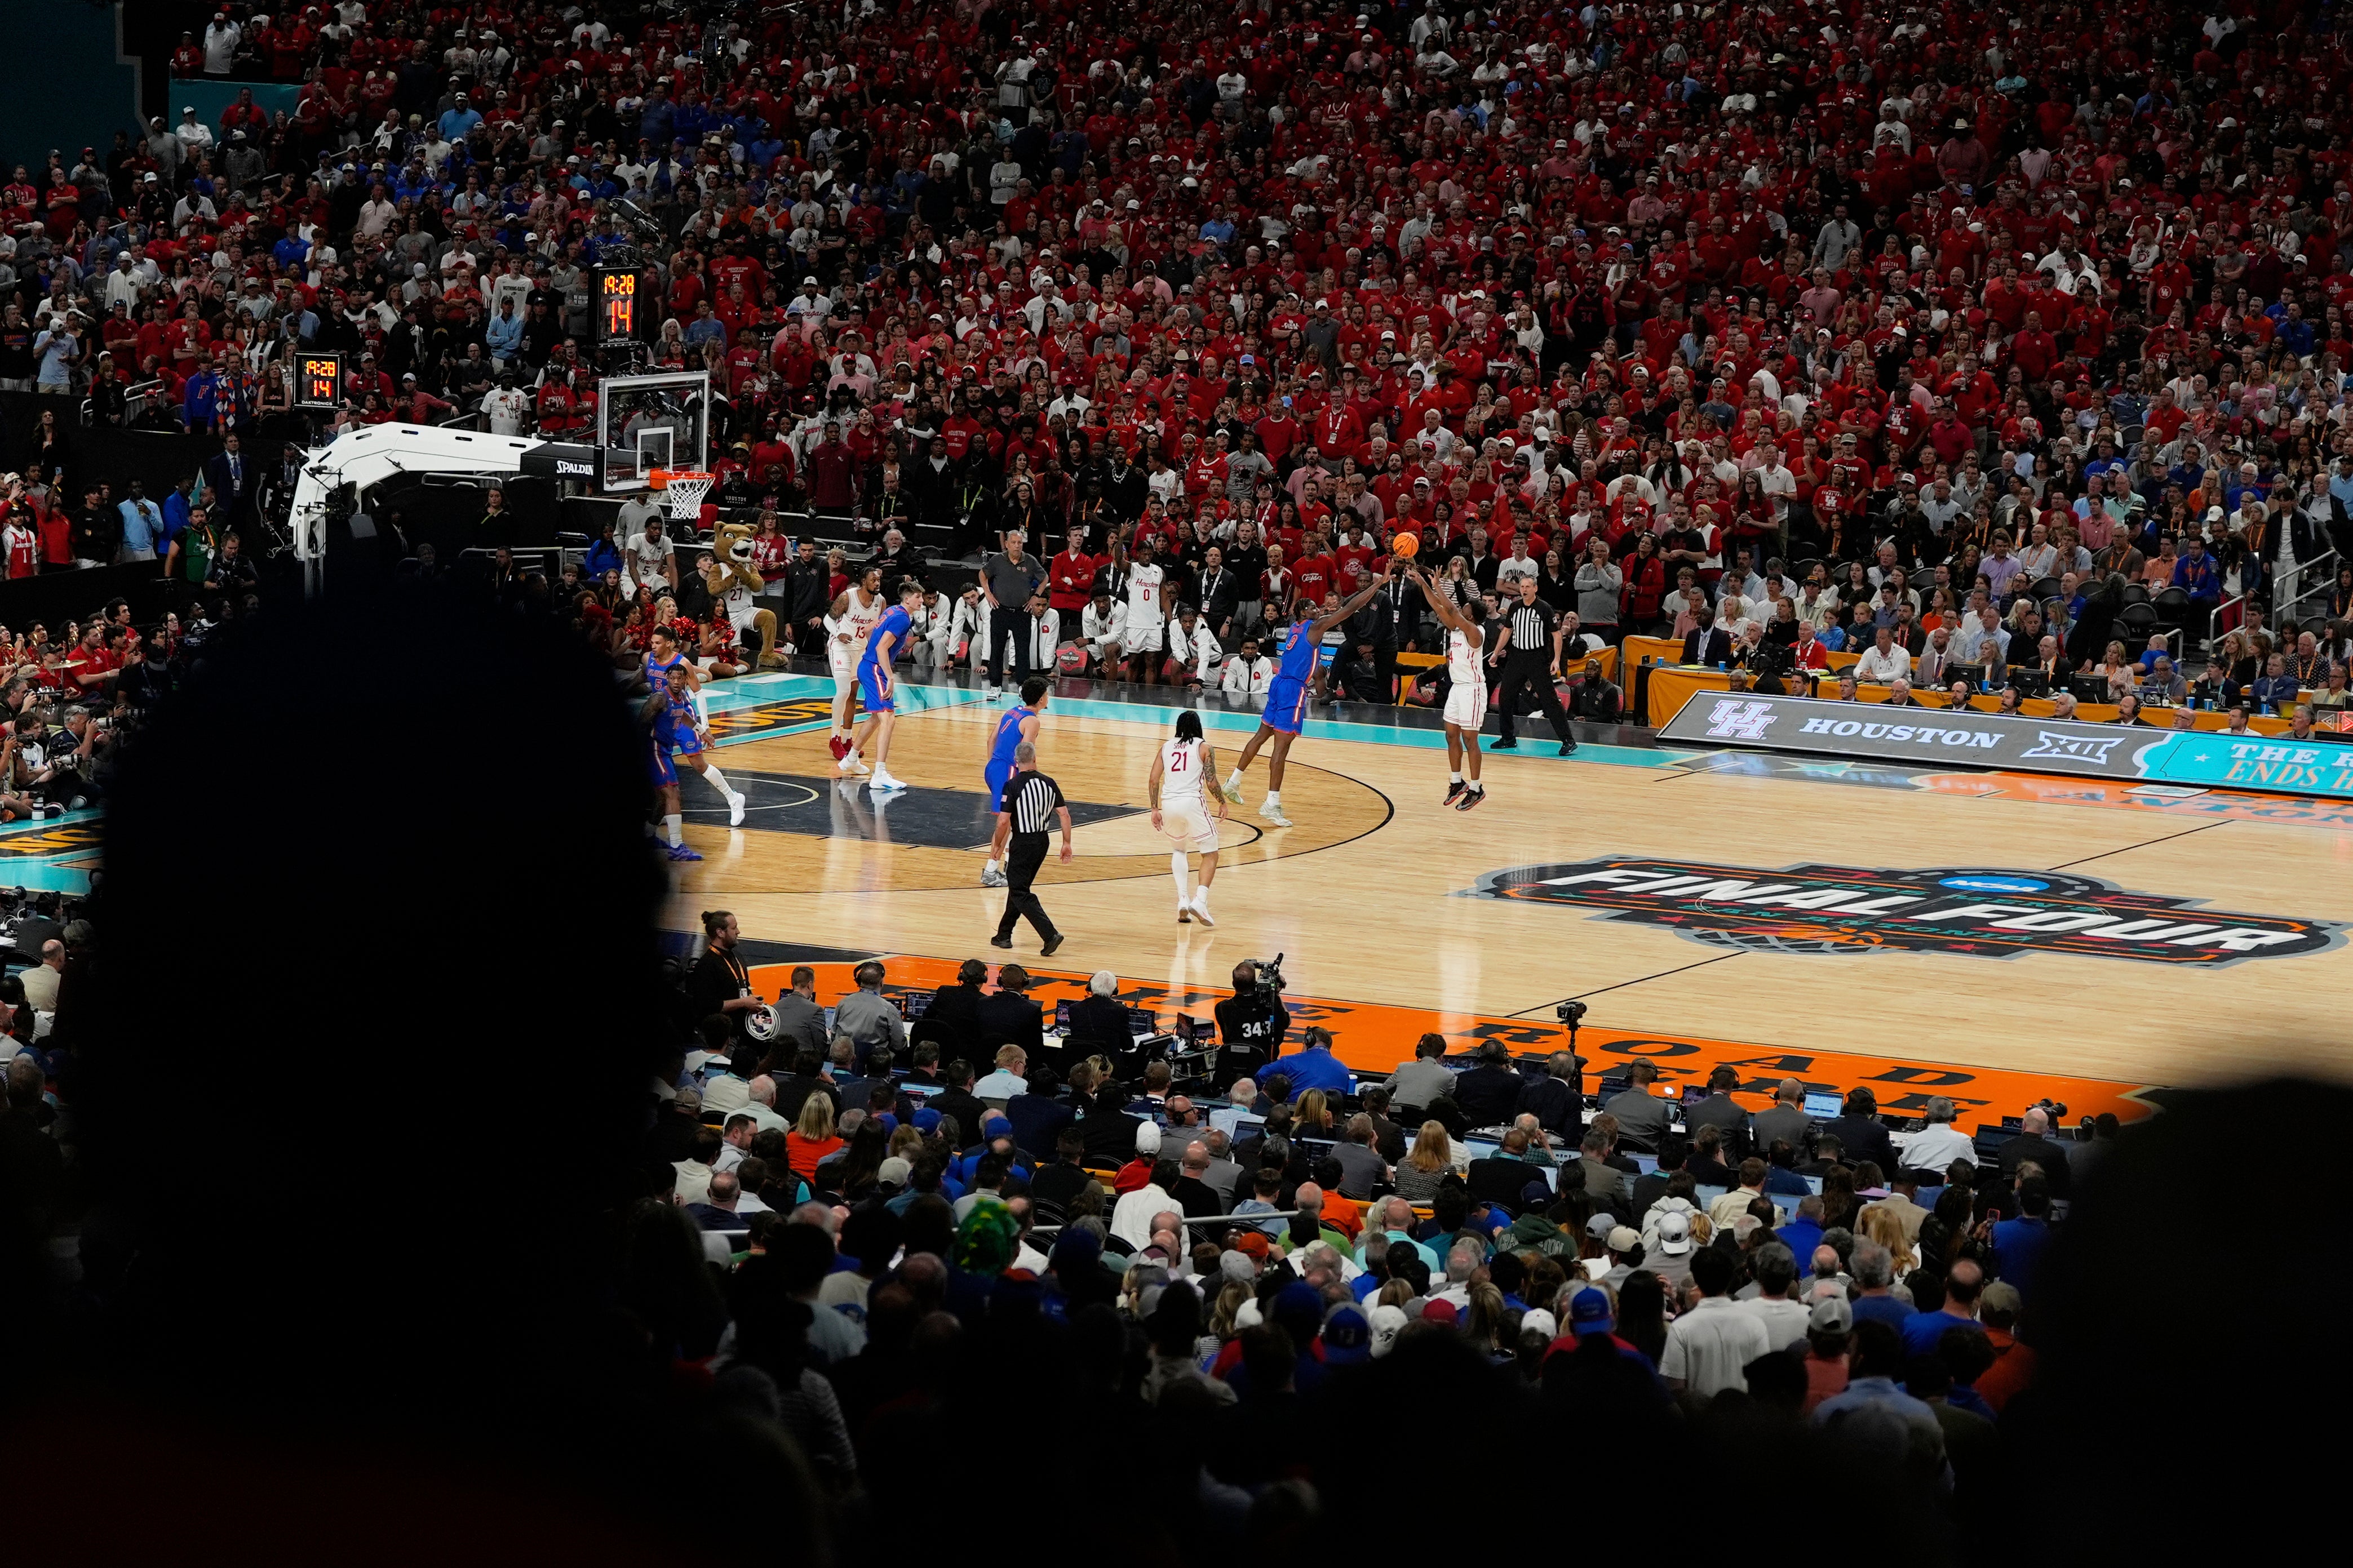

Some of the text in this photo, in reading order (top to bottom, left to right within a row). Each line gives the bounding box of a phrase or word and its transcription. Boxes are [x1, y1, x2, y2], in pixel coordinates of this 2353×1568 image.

[604, 274, 634, 296] 19:28
[611, 300, 632, 333] 14
[305, 359, 336, 377] 19:28
[312, 380, 330, 398] 14
[556, 460, 594, 476] SPALDIN
[638, 555, 659, 565] Houston
[642, 566, 649, 575] 5
[1135, 578, 1158, 588] Houston
[730, 587, 743, 601] 27
[1144, 589, 1149, 601] 0
[855, 626, 866, 639] 13
[654, 678, 662, 690] 5
[1799, 717, 2004, 749] HOUSTON
[1171, 751, 1187, 772] 21
[2230, 743, 2321, 764] THE
[2223, 760, 2326, 787] ENDS
[1536, 869, 1926, 916] FINAL
[1798, 881, 1932, 895] 2025
[1944, 879, 2040, 892] NCAA
[1677, 904, 2033, 940] SAN ANTONIO
[1907, 903, 2308, 950] FOUR
[1448, 1023, 1977, 1086] ROAD
